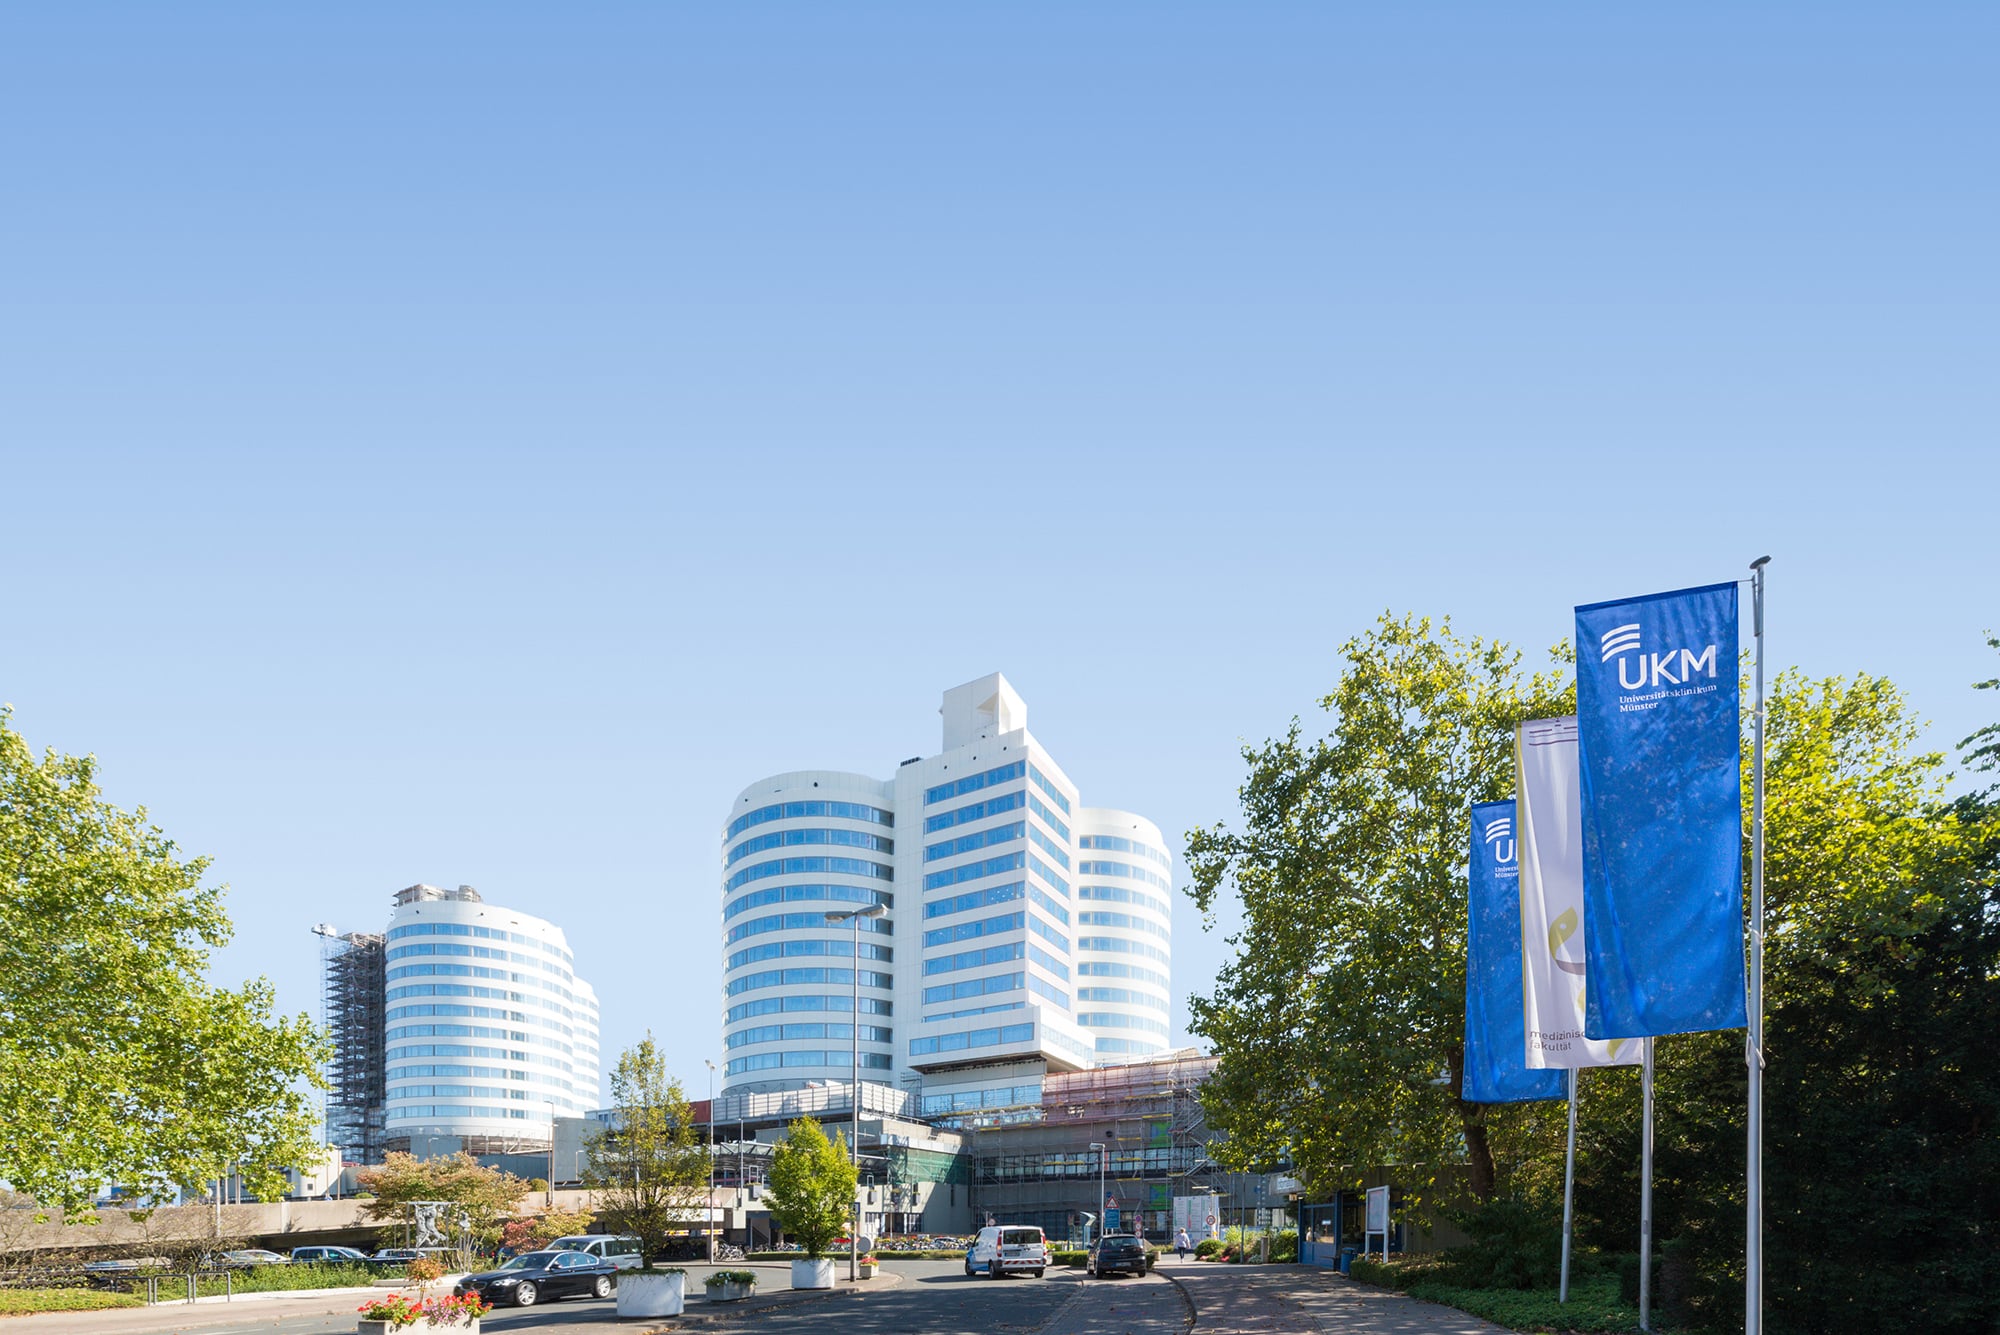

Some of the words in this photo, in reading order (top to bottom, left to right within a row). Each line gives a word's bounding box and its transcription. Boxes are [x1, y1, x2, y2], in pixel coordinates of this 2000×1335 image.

[1618, 645, 1717, 690] UKM
[1619, 685, 1717, 703] Universitätsklinikum
[1619, 702, 1658, 712] Münster
[1495, 839, 1518, 863] U
[1530, 1030, 1585, 1041] medizinisc
[1530, 1040, 1571, 1051] fakultät
